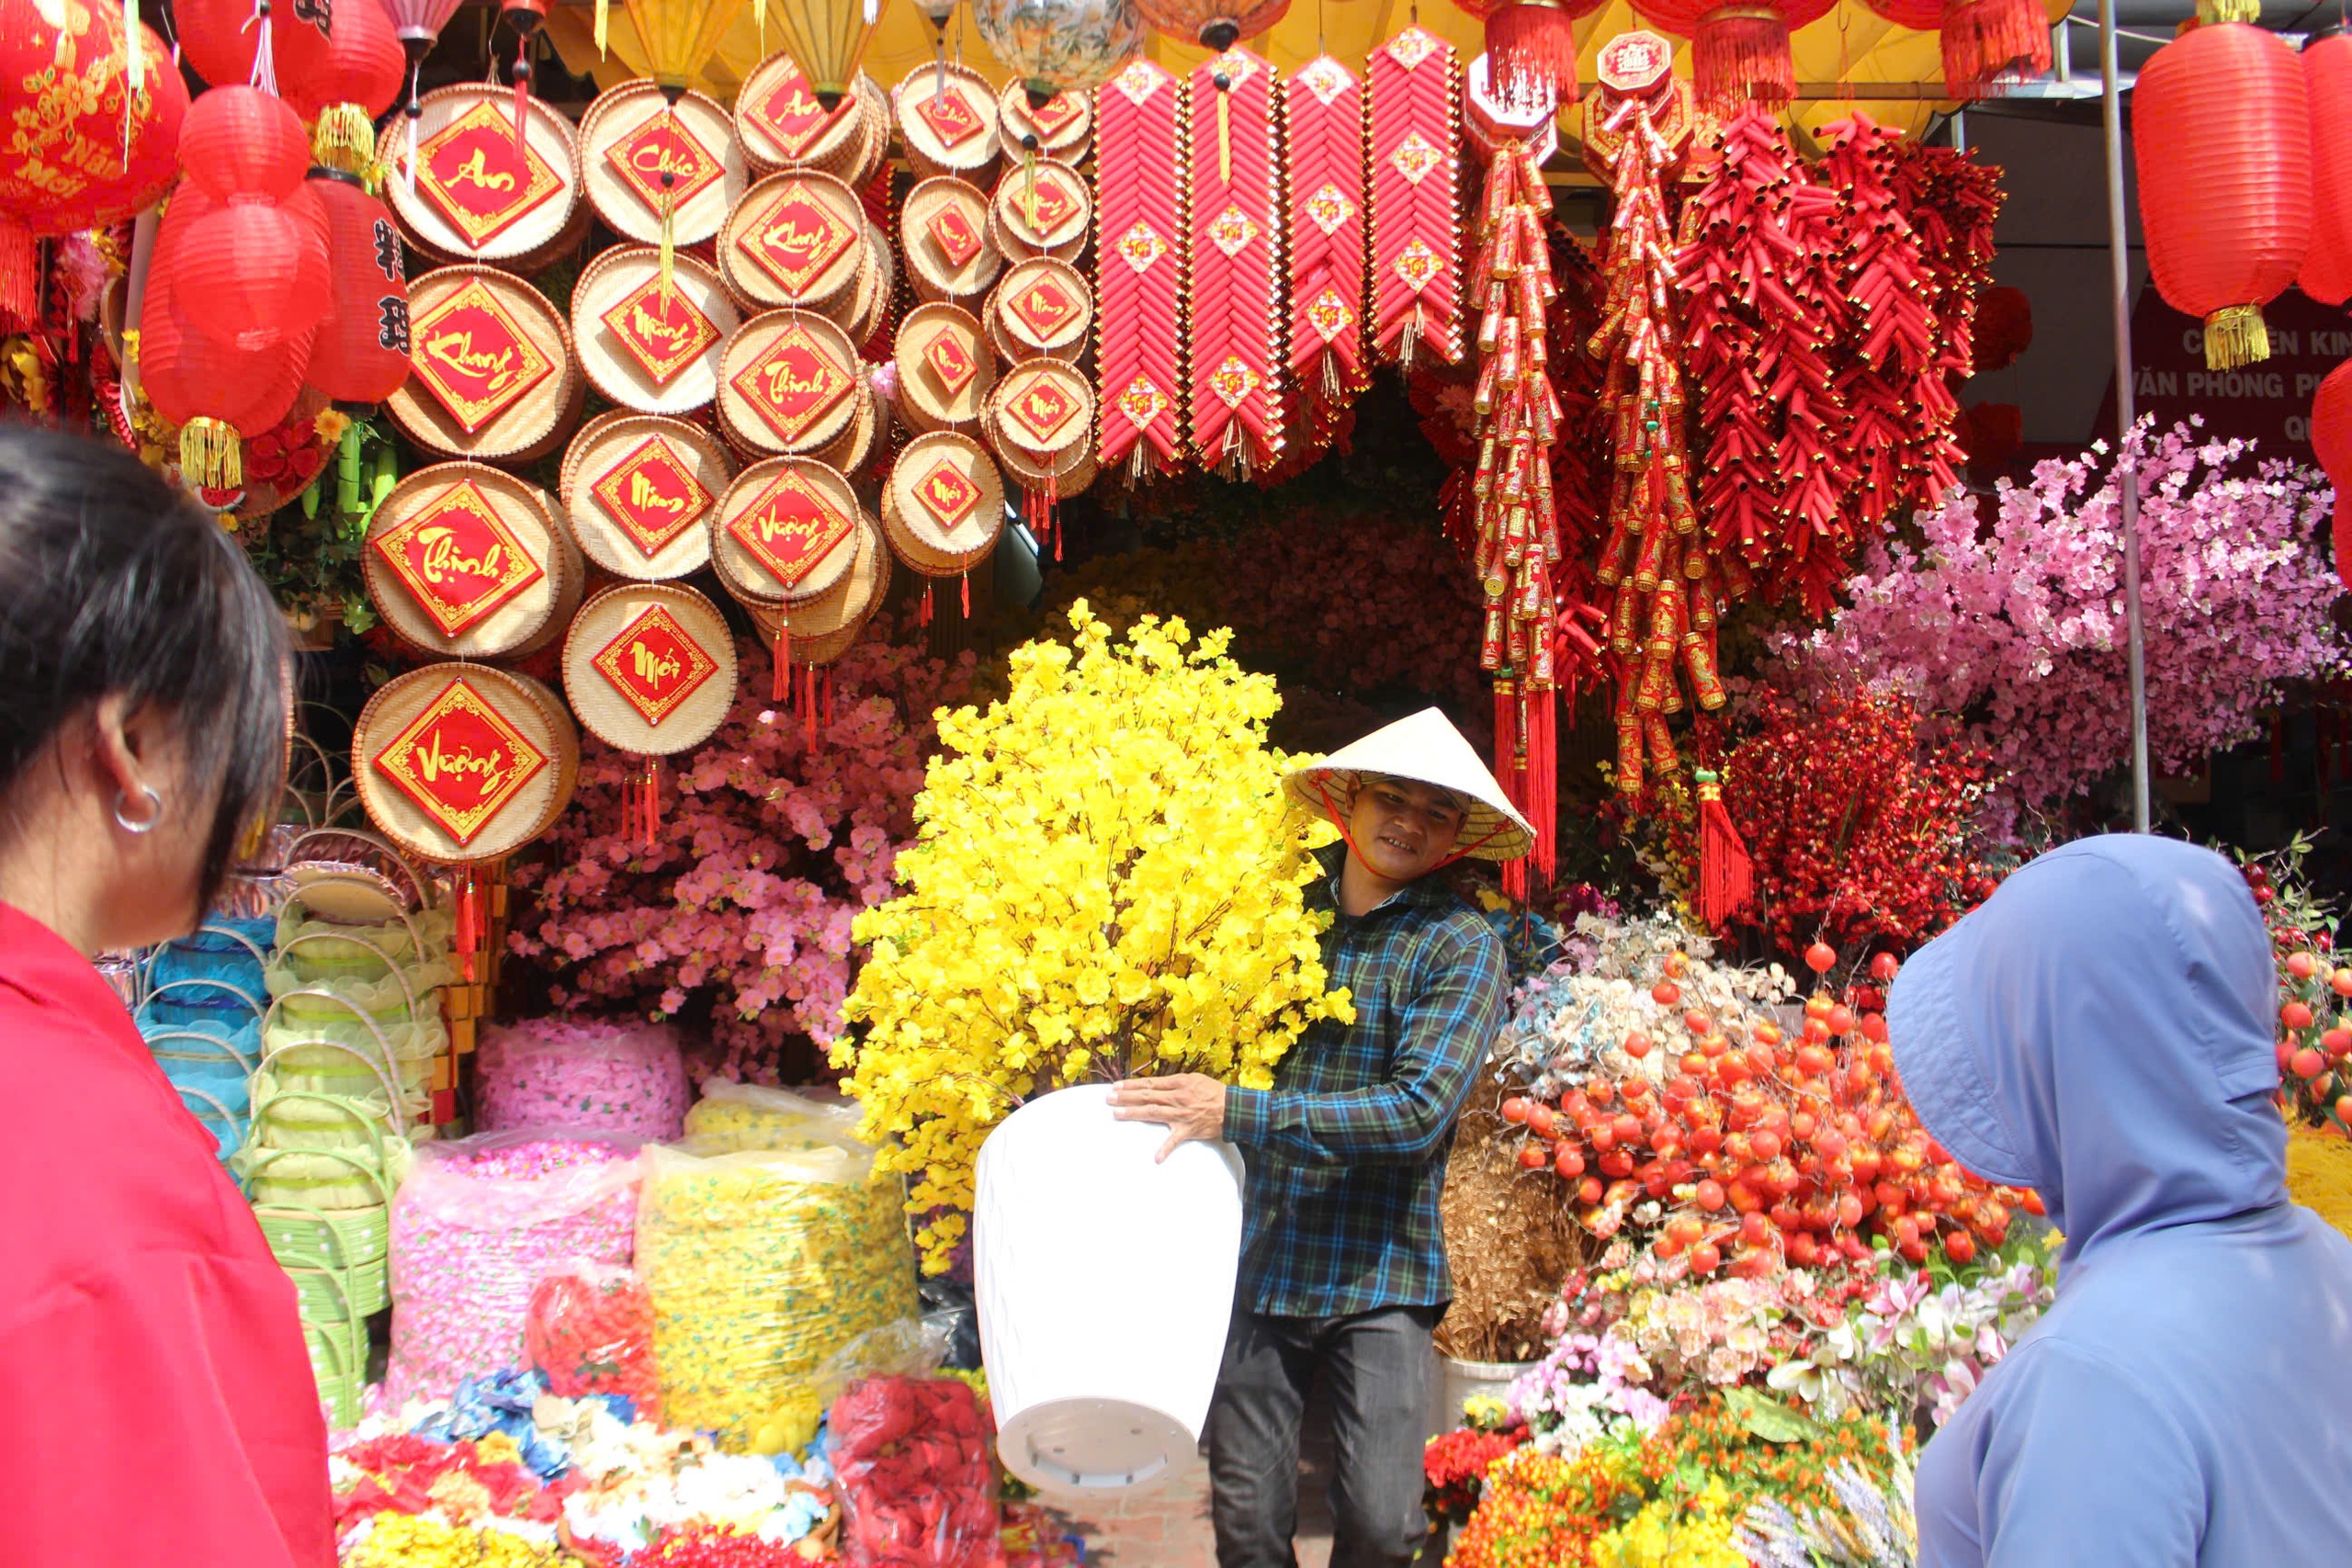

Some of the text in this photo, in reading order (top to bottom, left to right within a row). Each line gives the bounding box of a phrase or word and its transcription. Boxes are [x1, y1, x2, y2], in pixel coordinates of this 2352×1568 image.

[774, 89, 822, 125] An
[443, 147, 515, 193] An
[633, 143, 696, 177] Chúc
[763, 220, 828, 260] Khang
[426, 331, 518, 390] Khang
[764, 361, 824, 404] Thịnh
[758, 503, 826, 551] Vượng
[417, 526, 502, 583] Thịnh
[628, 641, 681, 691] Mới
[416, 728, 509, 795] Vượng
